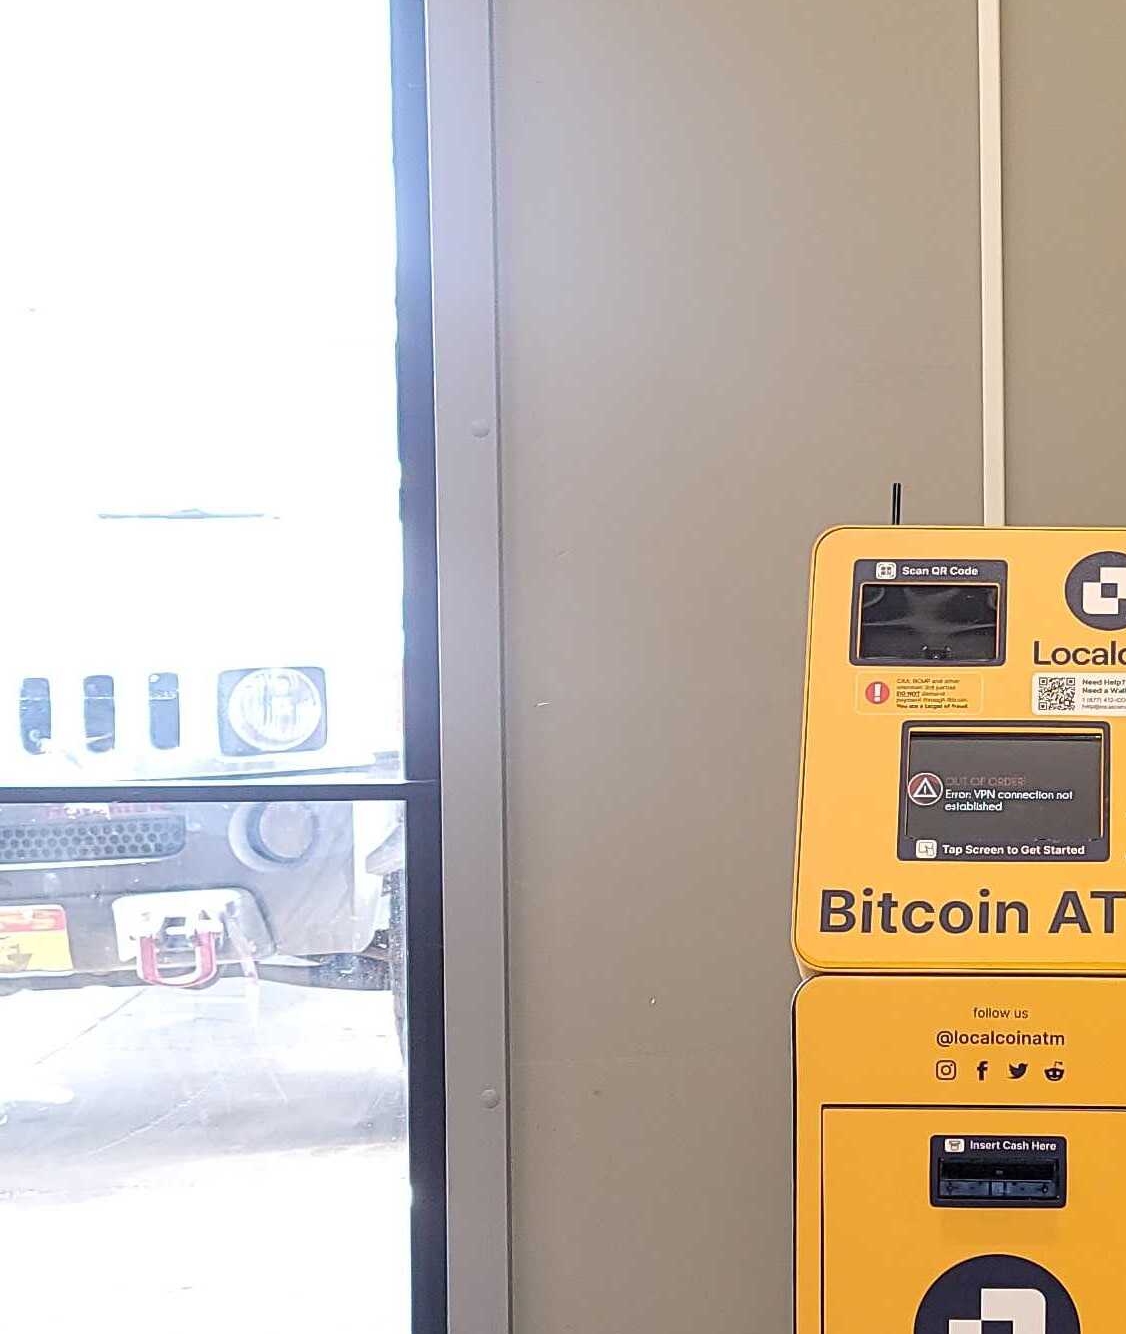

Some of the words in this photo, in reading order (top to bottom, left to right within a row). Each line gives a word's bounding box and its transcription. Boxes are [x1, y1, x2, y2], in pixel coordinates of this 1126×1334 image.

[902, 566, 929, 576] Scan
[931, 566, 948, 576] QR
[950, 566, 979, 576] Code
[1104, 679, 1126, 687] Help?
[945, 776, 967, 786] OUT
[970, 776, 985, 786] OF
[945, 789, 972, 800] Error:
[973, 789, 996, 799] VPN
[998, 790, 1054, 800] connection
[1056, 790, 1073, 800] not
[945, 801, 1003, 812] established
[942, 844, 963, 856] Tap
[965, 844, 1004, 855] Screen
[1007, 845, 1018, 855] to
[1021, 844, 1041, 855] Get
[1043, 844, 1086, 855] Started
[819, 888, 1029, 934] Bitcoin
[973, 1007, 1011, 1019] follow
[1014, 1009, 1029, 1019] us
[936, 1030, 1066, 1048] @localcoinatm
[970, 1139, 1001, 1151] Insert
[1002, 1140, 1029, 1151] Cash
[1031, 1140, 1057, 1151] Here
